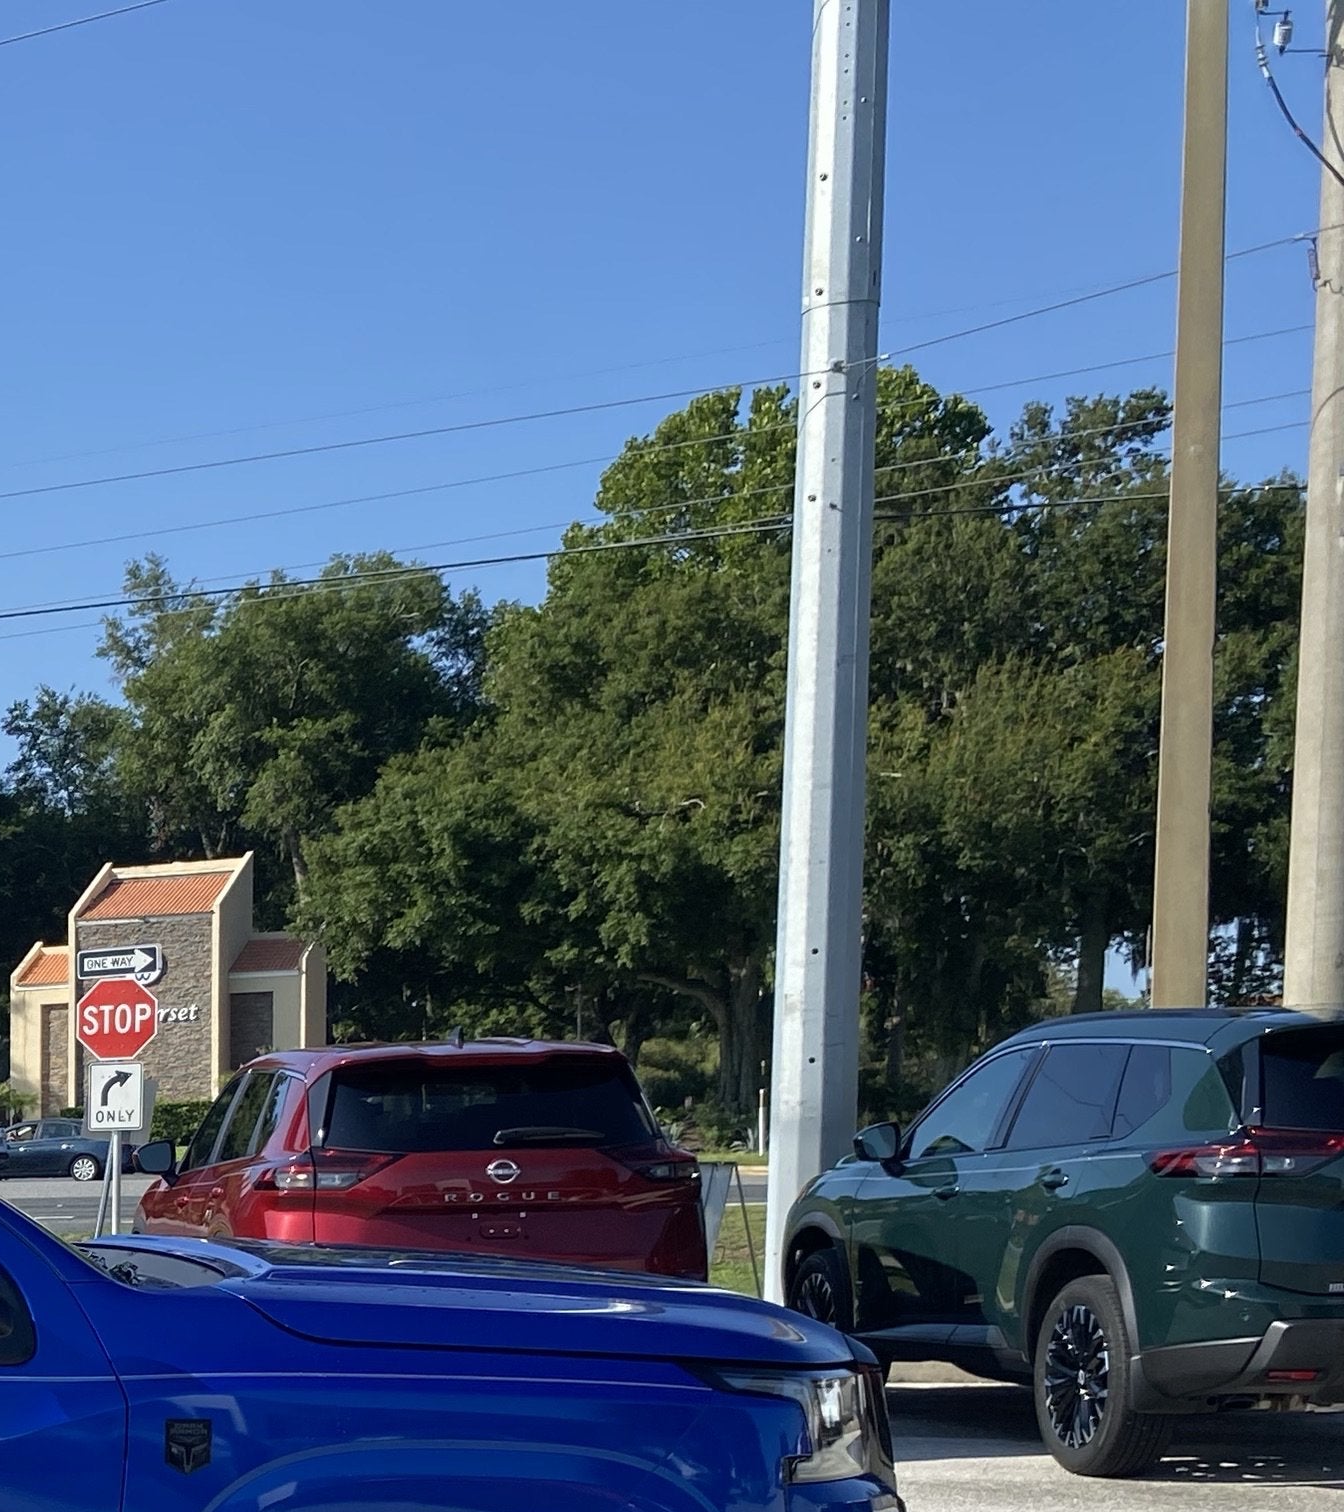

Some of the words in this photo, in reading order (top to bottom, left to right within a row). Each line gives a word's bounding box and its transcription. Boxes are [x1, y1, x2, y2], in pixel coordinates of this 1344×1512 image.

[86, 958, 108, 970] ONE
[110, 956, 133, 967] WAY
[82, 1003, 151, 1036] STOP
[157, 1003, 199, 1022] rset
[95, 1109, 135, 1124] ONLY
[444, 1191, 560, 1203] ROGUE
